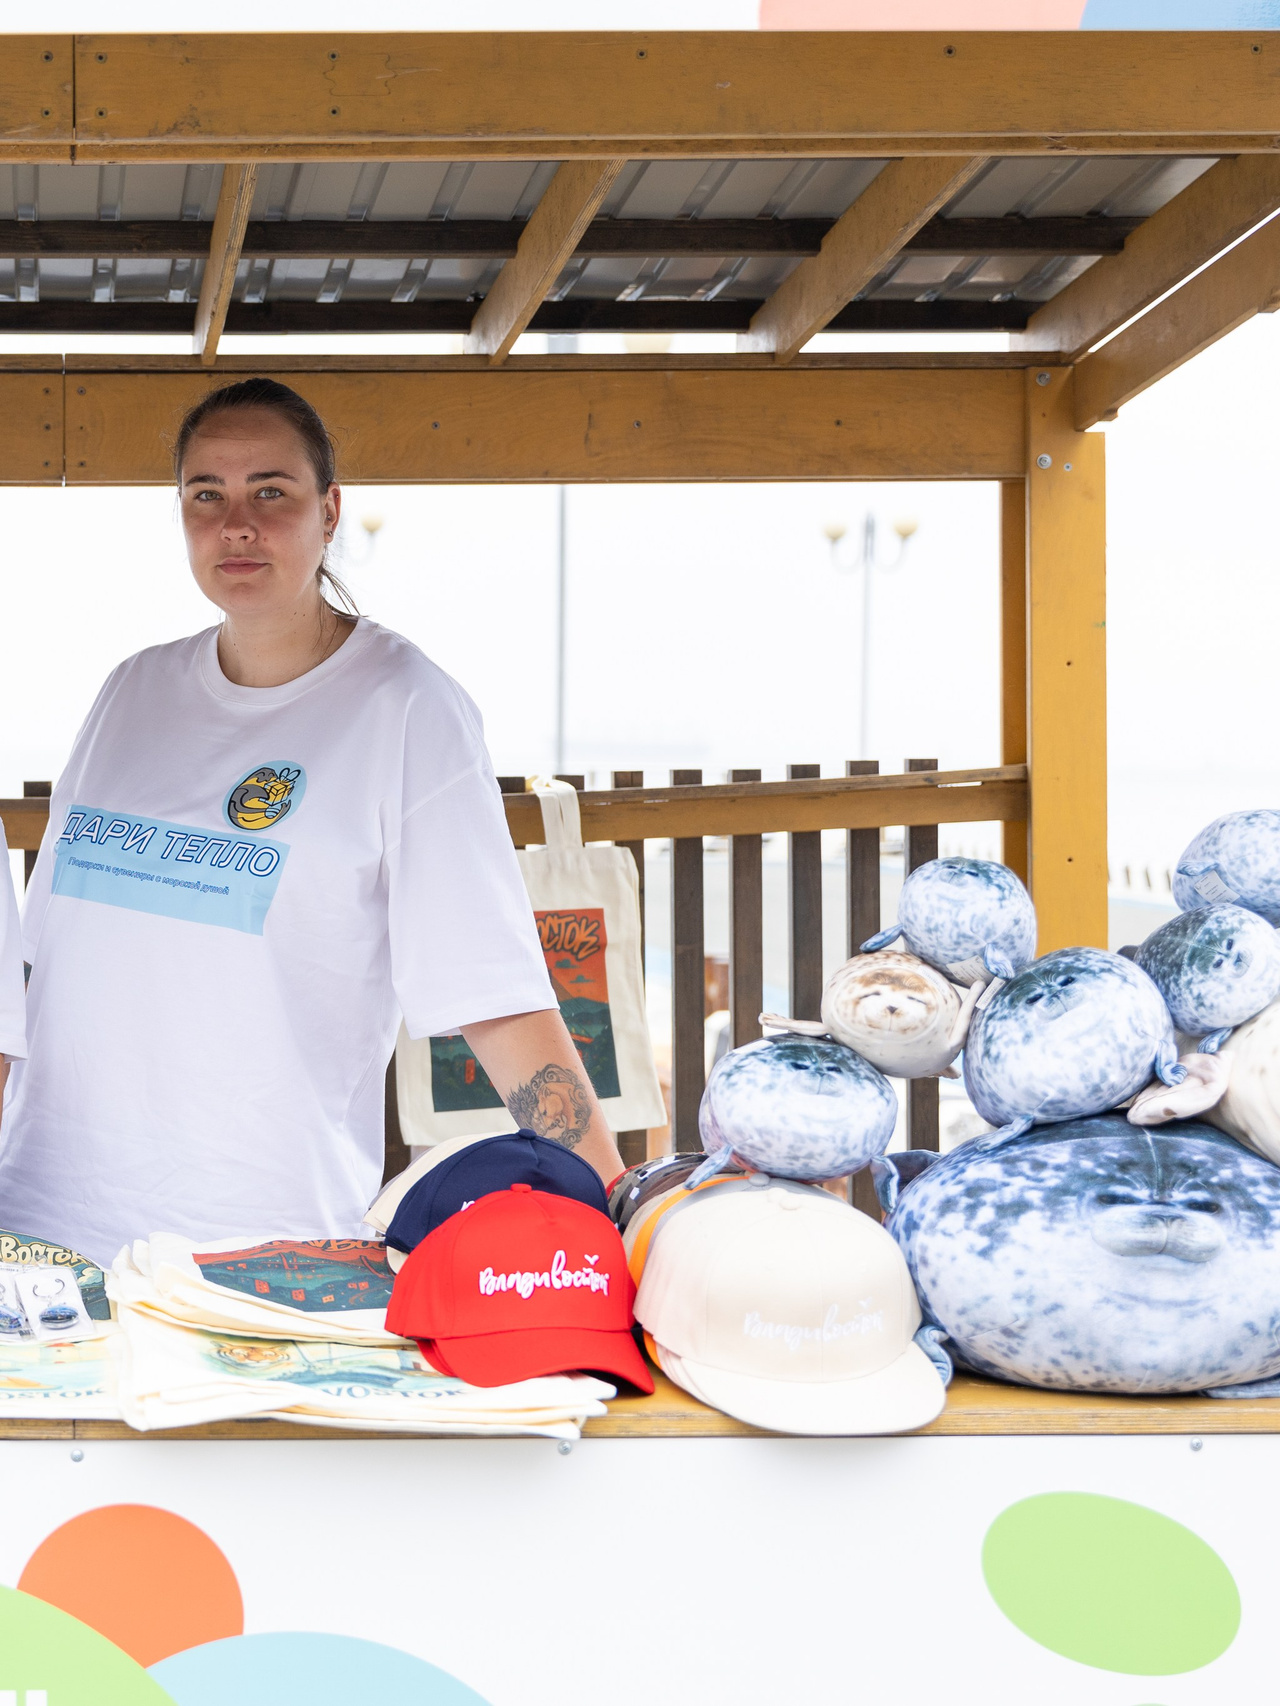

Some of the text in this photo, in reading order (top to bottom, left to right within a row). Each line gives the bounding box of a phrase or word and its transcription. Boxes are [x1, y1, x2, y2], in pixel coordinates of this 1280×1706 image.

[57, 811, 281, 878] ДАРИ ТЕПЛО
[67, 856, 104, 872] Подарки
[111, 867, 155, 882] сувениры
[162, 876, 201, 891] морской
[200, 883, 230, 896] душой
